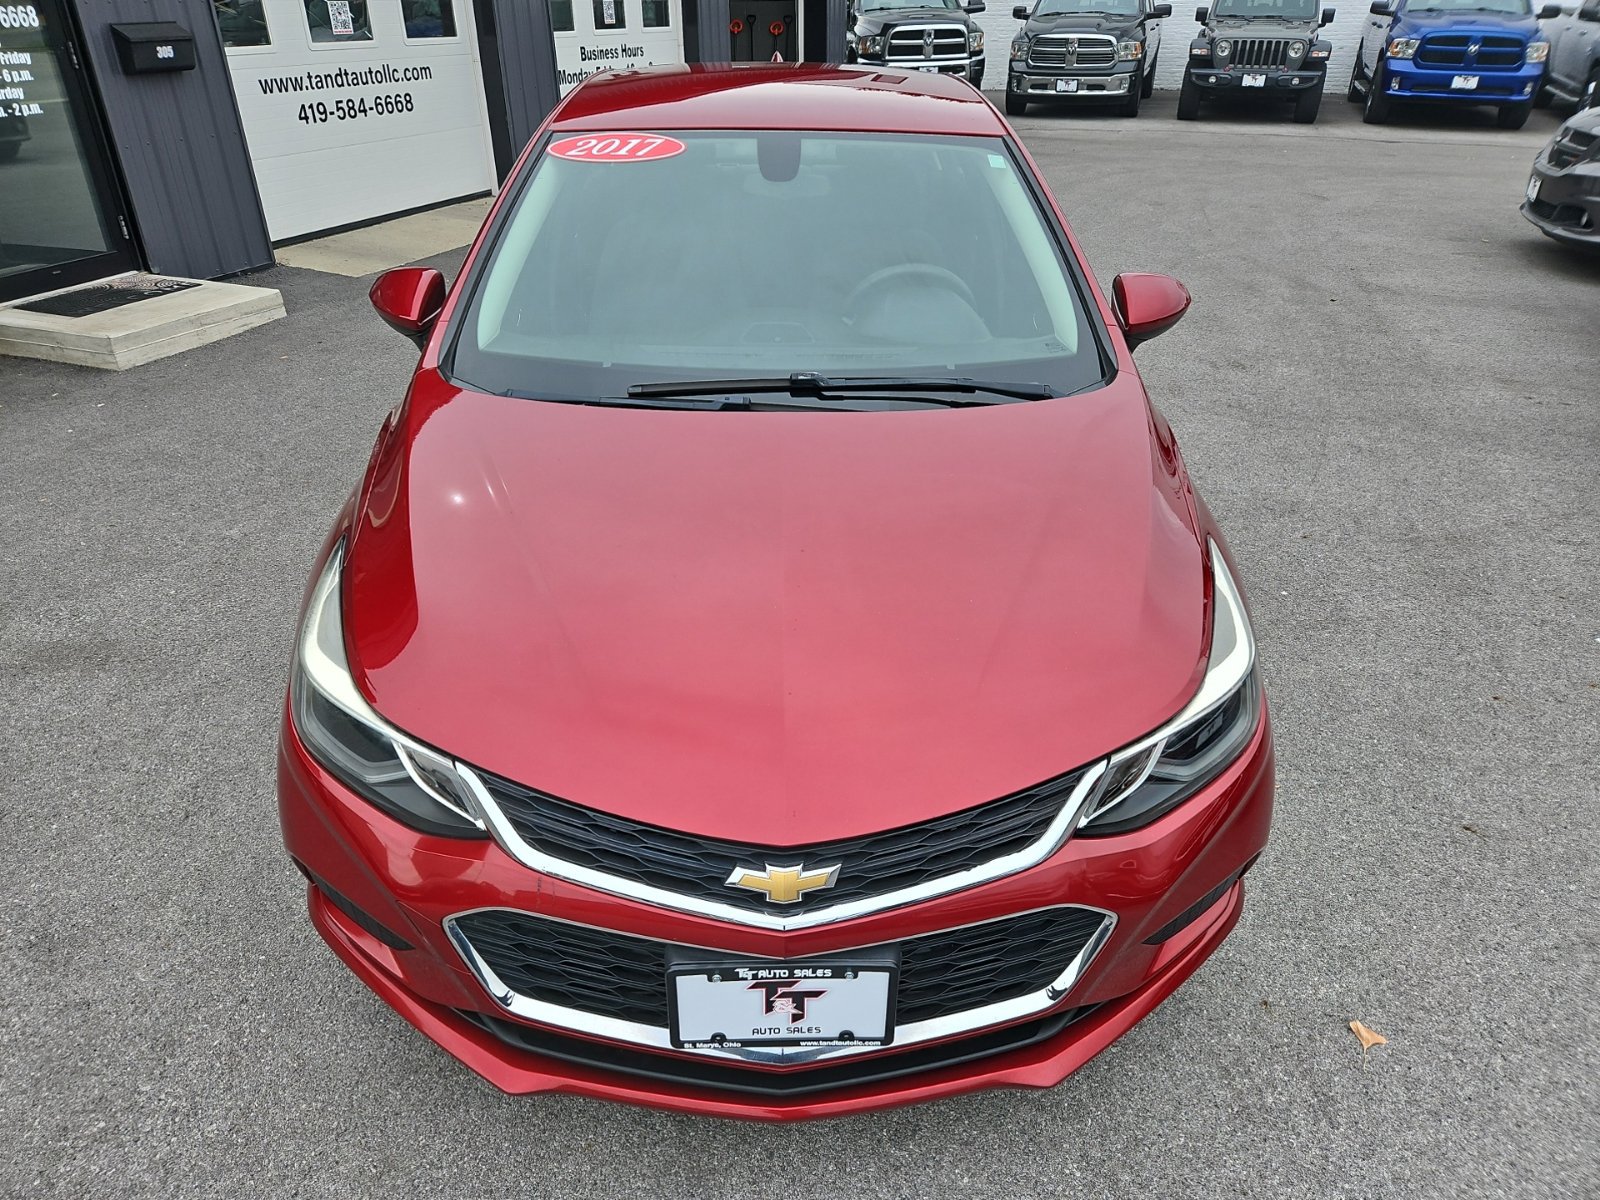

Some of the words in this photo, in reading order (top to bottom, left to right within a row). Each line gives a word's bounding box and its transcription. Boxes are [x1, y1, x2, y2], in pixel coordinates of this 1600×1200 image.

[0, 5, 39, 28] 6668
[156, 45, 175, 59] 305
[580, 46, 619, 62] Business
[621, 43, 644, 58] Hours
[2, 68, 12, 83] 6
[11, 70, 35, 83] p.m.
[258, 63, 432, 95] www.tandtautollc.com
[12, 102, 22, 116] 2
[21, 103, 44, 117] p.m.
[298, 92, 414, 125] 419-584-6668
[564, 138, 666, 156] 2017
[758, 968, 789, 979] AUTO
[793, 967, 832, 978] SALES
[752, 1027, 781, 1036] AUTO
[786, 1026, 822, 1034] SALES
